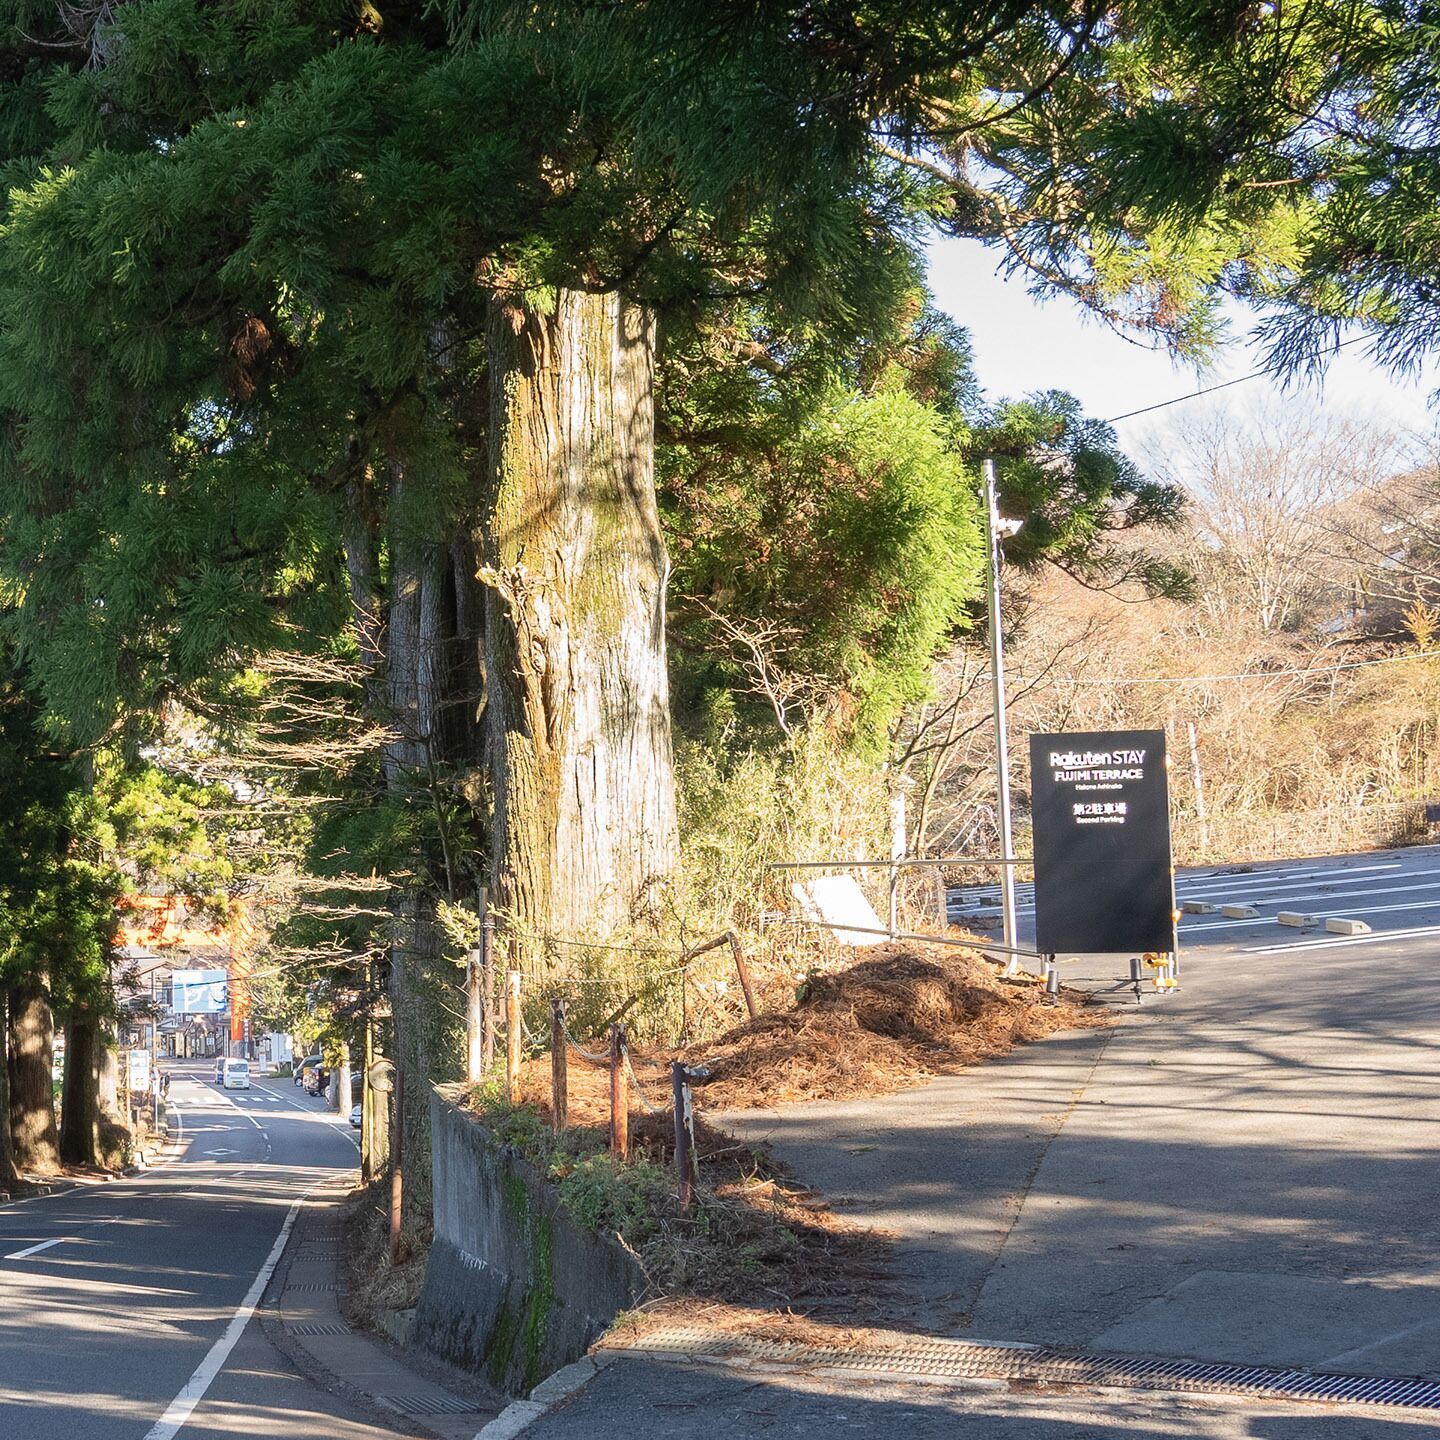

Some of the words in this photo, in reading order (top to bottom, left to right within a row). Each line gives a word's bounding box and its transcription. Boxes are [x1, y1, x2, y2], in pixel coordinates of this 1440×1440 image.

[1050, 751, 1111, 766] Rakuten
[1112, 750, 1146, 764] STAY
[1055, 771, 1090, 781] FUJIMI
[1092, 769, 1144, 779] TERRACE
[1073, 802, 1126, 815] 第2駐車場
